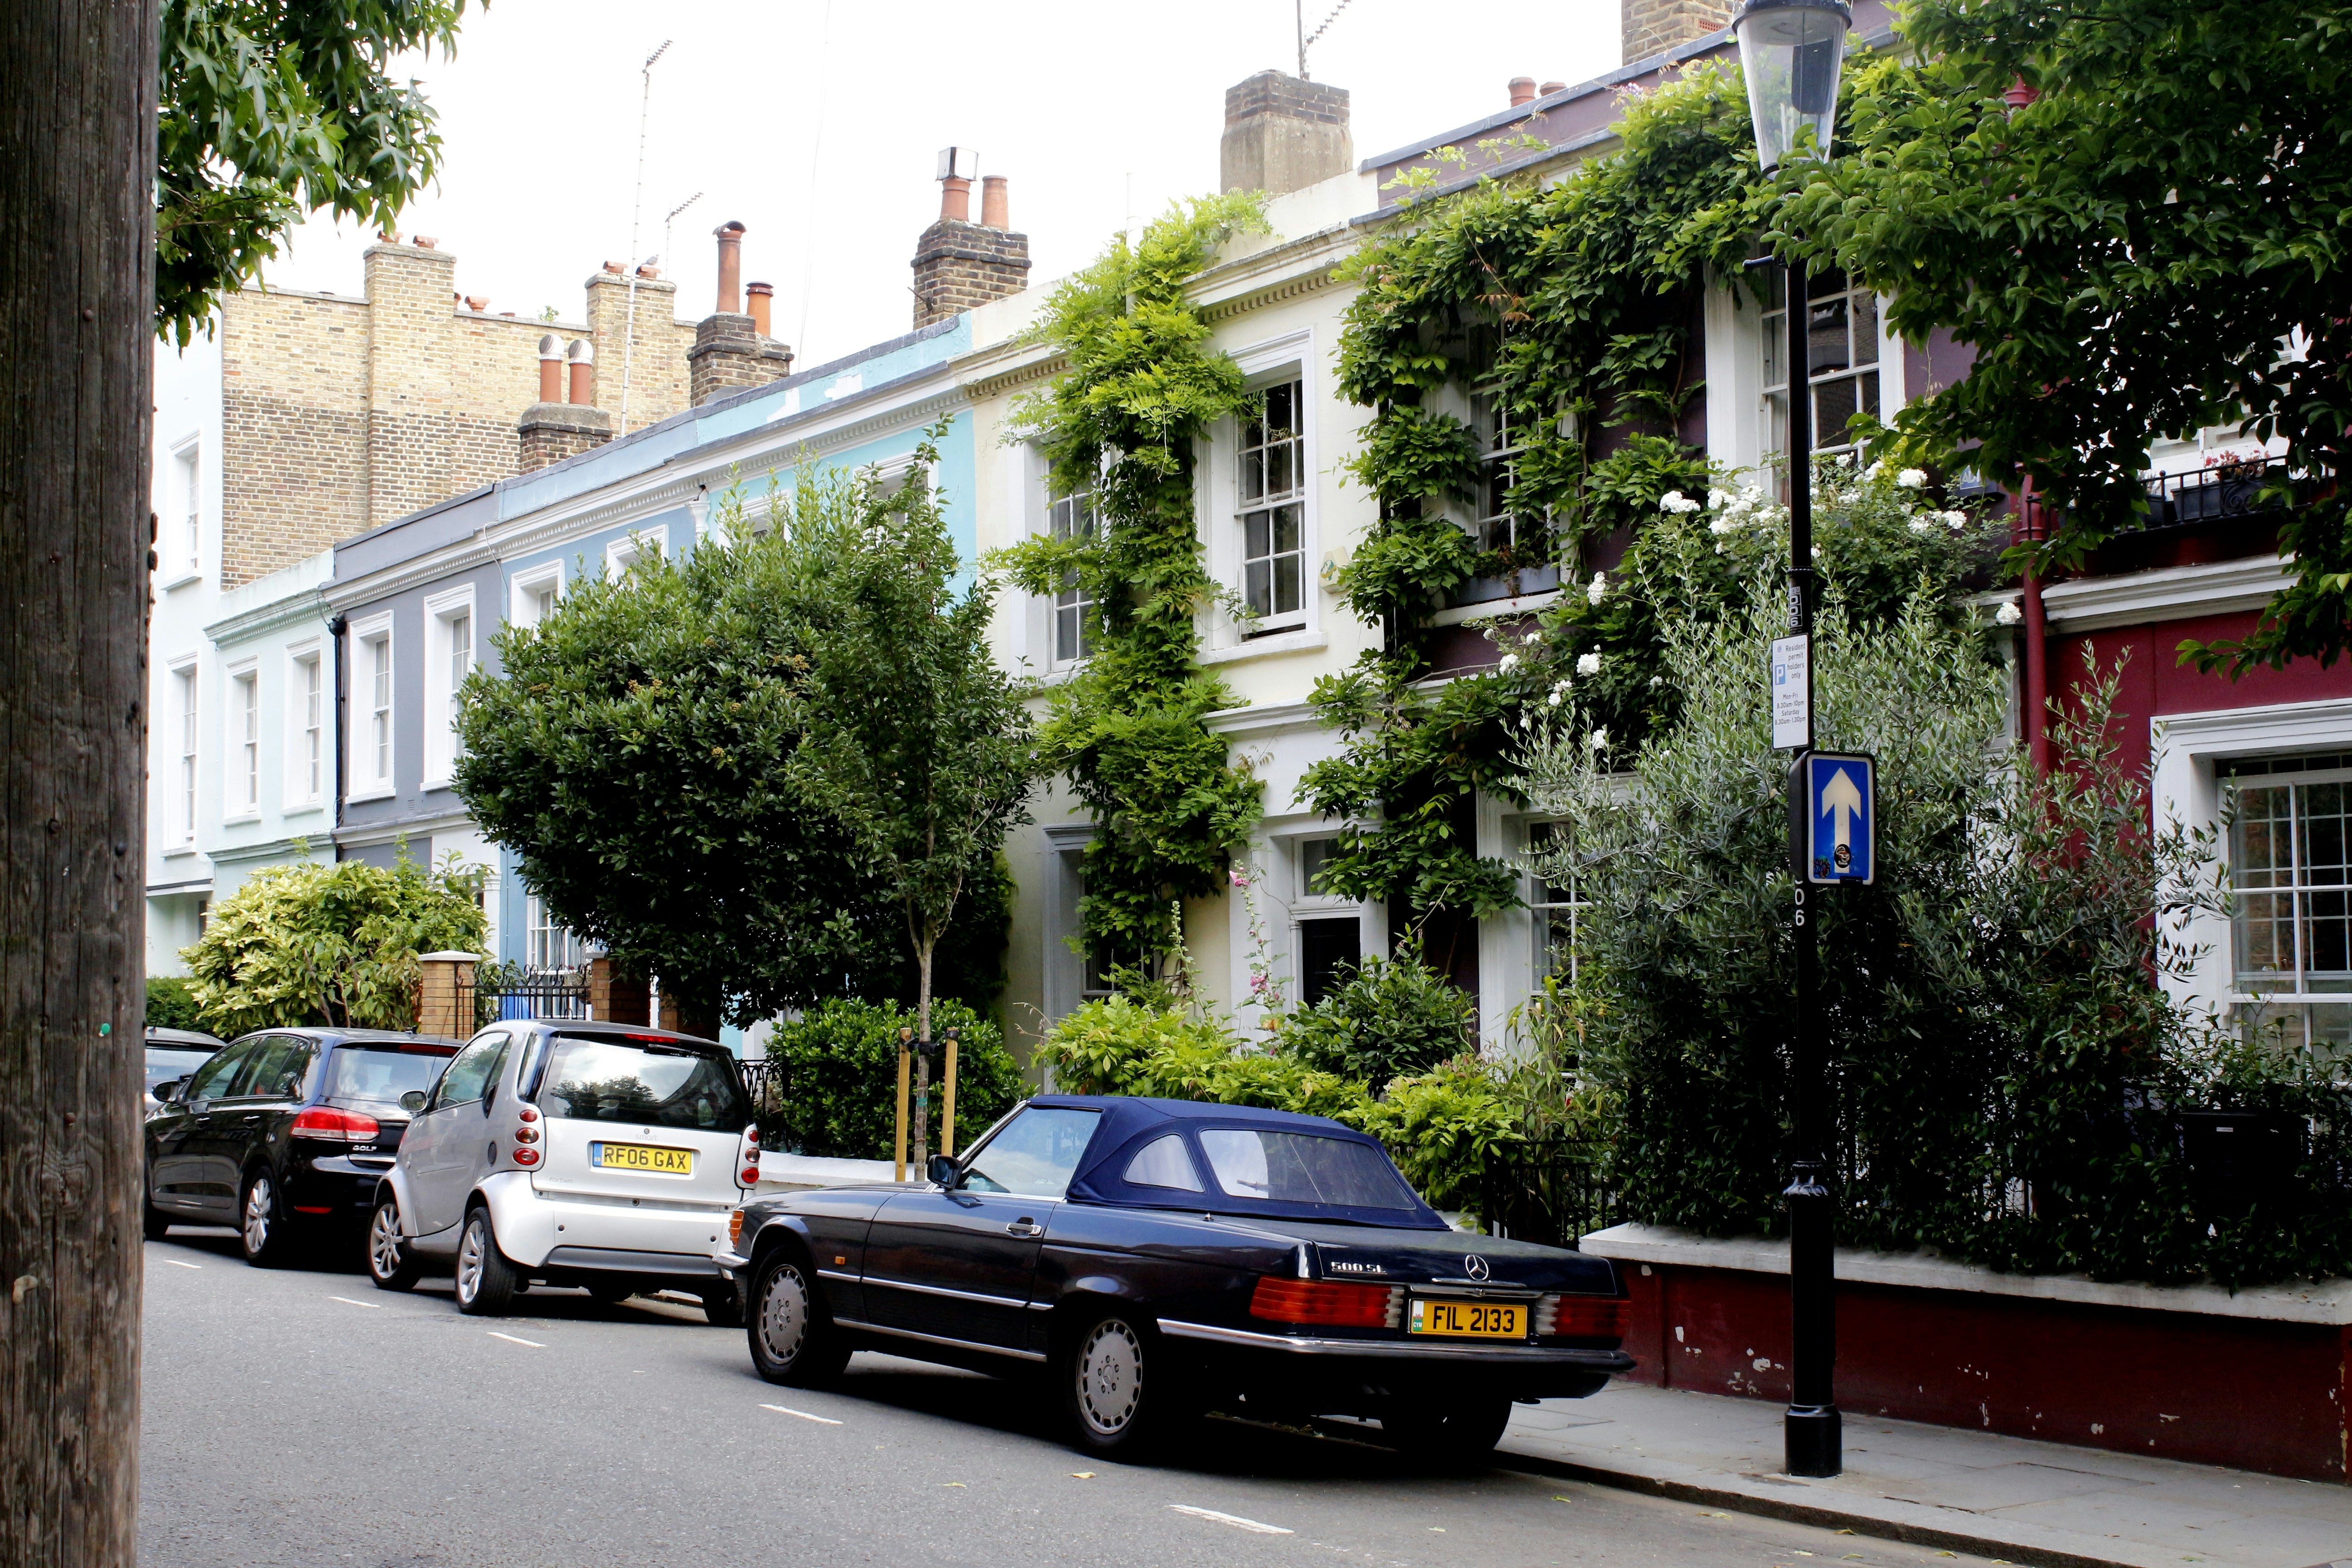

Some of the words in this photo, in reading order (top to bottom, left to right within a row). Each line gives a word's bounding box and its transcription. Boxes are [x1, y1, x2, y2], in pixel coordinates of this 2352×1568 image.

[1785, 643, 1806, 652] Resident
[1788, 652, 1803, 662] permit
[1776, 666, 1784, 684] P
[1777, 701, 1804, 709] 8.30am-10pm
[603, 1146, 649, 1166] RF06
[654, 1151, 686, 1170] GAX
[1331, 1261, 1363, 1271] 500
[1366, 1264, 1386, 1273] SL
[1433, 1306, 1464, 1330] FIL
[1470, 1308, 1514, 1333] 2133
